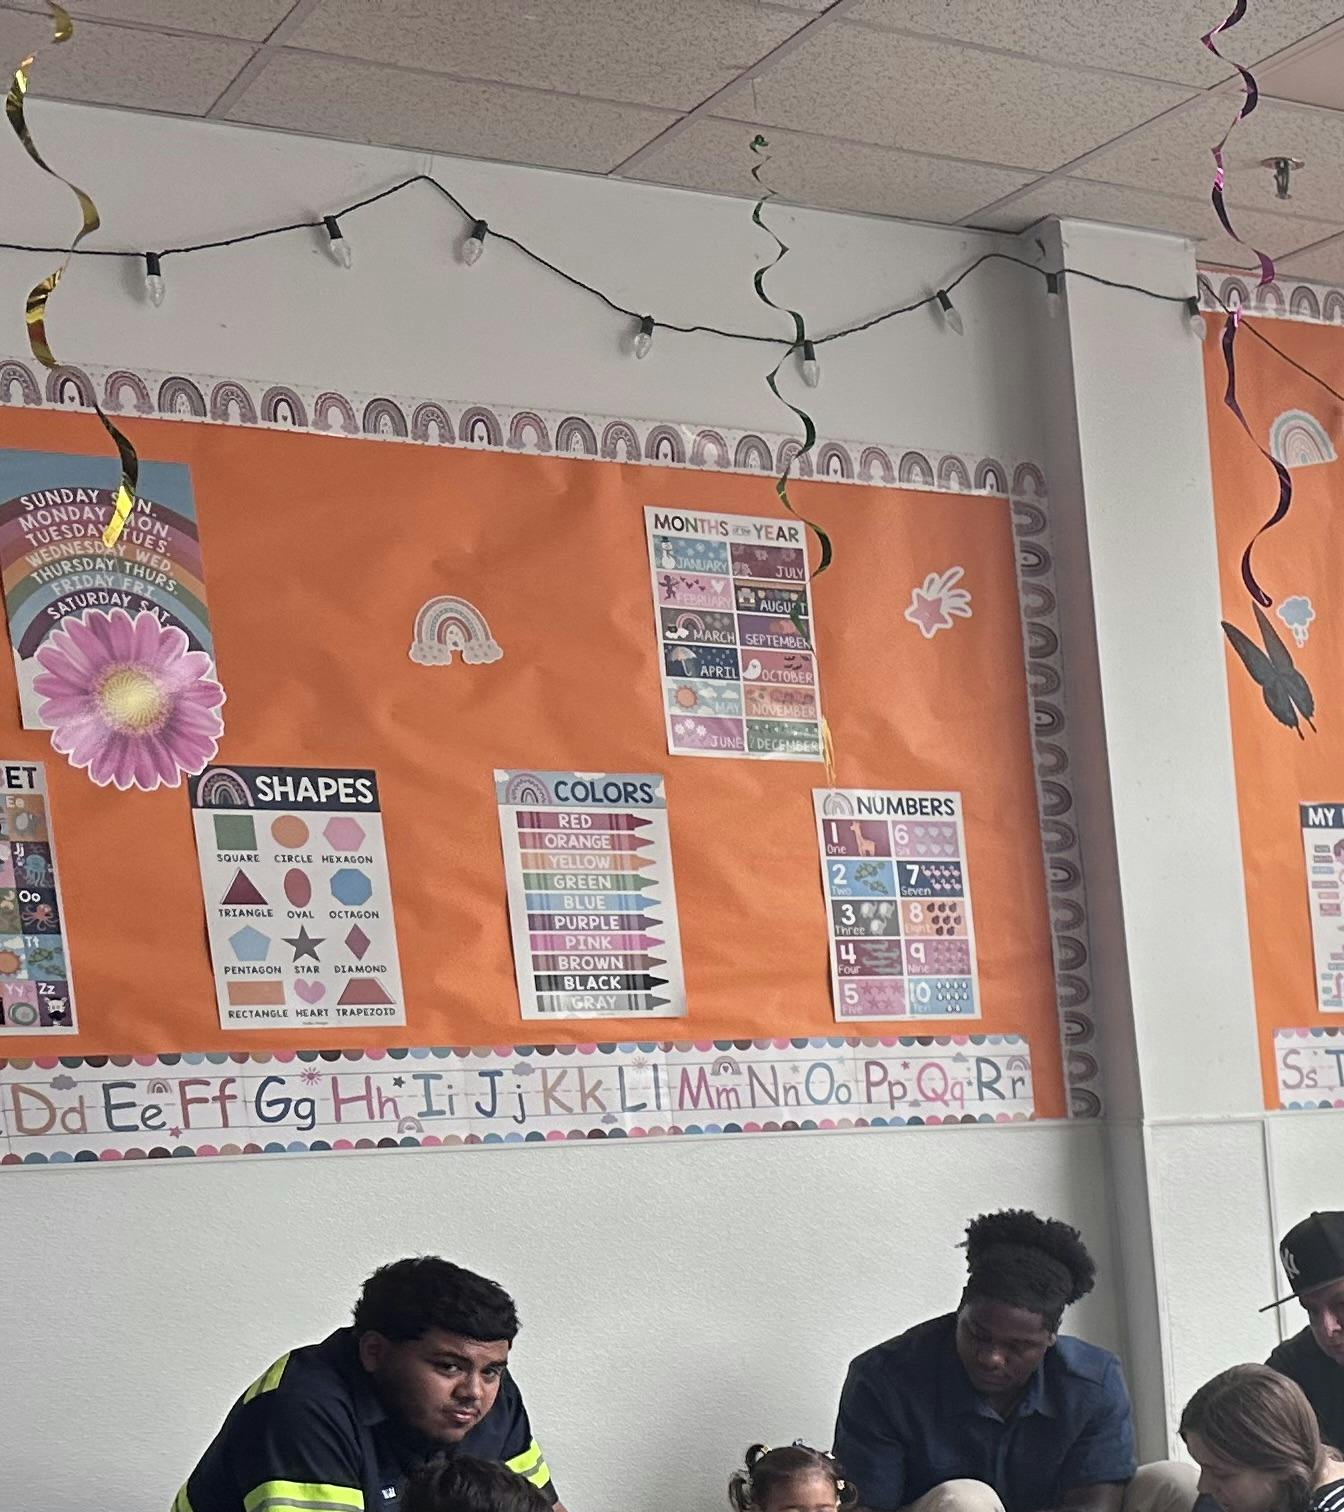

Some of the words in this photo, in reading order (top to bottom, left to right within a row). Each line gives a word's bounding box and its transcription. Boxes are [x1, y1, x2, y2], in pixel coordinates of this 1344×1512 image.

[20, 489, 99, 511] SUNDAY
[111, 492, 156, 517] SN.
[19, 505, 106, 532] MONDAY
[654, 513, 729, 537] MONTHS
[752, 523, 799, 543] YEAR
[122, 528, 171, 557] TUES.
[676, 556, 728, 573] JANUARY
[775, 566, 804, 579] JULY
[30, 557, 117, 585] THURSDAY
[124, 562, 178, 595] THURS.
[51, 574, 115, 596] FRIDAY
[47, 591, 132, 620] SATURDAY
[693, 630, 735, 643] MARCH
[701, 665, 738, 679] APRIL
[762, 670, 813, 683] OCTOBER
[715, 701, 740, 713] MAY
[752, 704, 815, 717] NOVEMBER
[711, 735, 744, 749] JUNE
[255, 776, 374, 803] SHAPES
[554, 780, 654, 804] COLORS
[857, 797, 955, 816] NUMBERS
[559, 814, 592, 829] RED
[1308, 808, 1335, 827] MY
[545, 834, 610, 849] ORANGE
[895, 824, 909, 845] 6
[216, 854, 260, 863] SQUARE
[274, 854, 313, 863] CIRCLE
[322, 855, 373, 864] HEXAGON
[549, 854, 611, 869] YELLOW
[832, 863, 848, 885] 2
[906, 864, 919, 885] 7
[554, 875, 611, 889] GREEN
[19, 890, 41, 902] Oo
[901, 885, 931, 896] Seven
[563, 895, 606, 910] BLUE
[219, 909, 273, 918] TRIANGLE
[287, 910, 314, 919] OVAL
[329, 910, 379, 919] OCTAGON
[841, 904, 856, 926] 3
[909, 902, 923, 923] 8
[554, 916, 620, 930] PURPLE
[836, 925, 865, 936] Three
[564, 935, 612, 949] PINK
[840, 943, 856, 964] 4
[910, 943, 925, 963] 9
[224, 965, 281, 975] PENTAGON
[294, 965, 320, 974] STAR
[334, 965, 387, 973] DIAMOND
[558, 956, 624, 971] BROWN
[838, 964, 861, 975] Four
[38, 983, 56, 995] Zz
[563, 975, 621, 990] BLACK
[844, 983, 859, 1004] 5
[910, 981, 930, 1001] 10
[571, 996, 617, 1010] GRAY
[228, 1010, 288, 1019] RECTANGLE
[295, 1009, 329, 1017] HEART
[336, 1008, 395, 1017] TRAPEZOID
[11, 1082, 88, 1136] Dd
[102, 1081, 167, 1131] Ee
[178, 1077, 237, 1130] Ff
[255, 1075, 316, 1131] Gg
[332, 1075, 401, 1124] Hh
